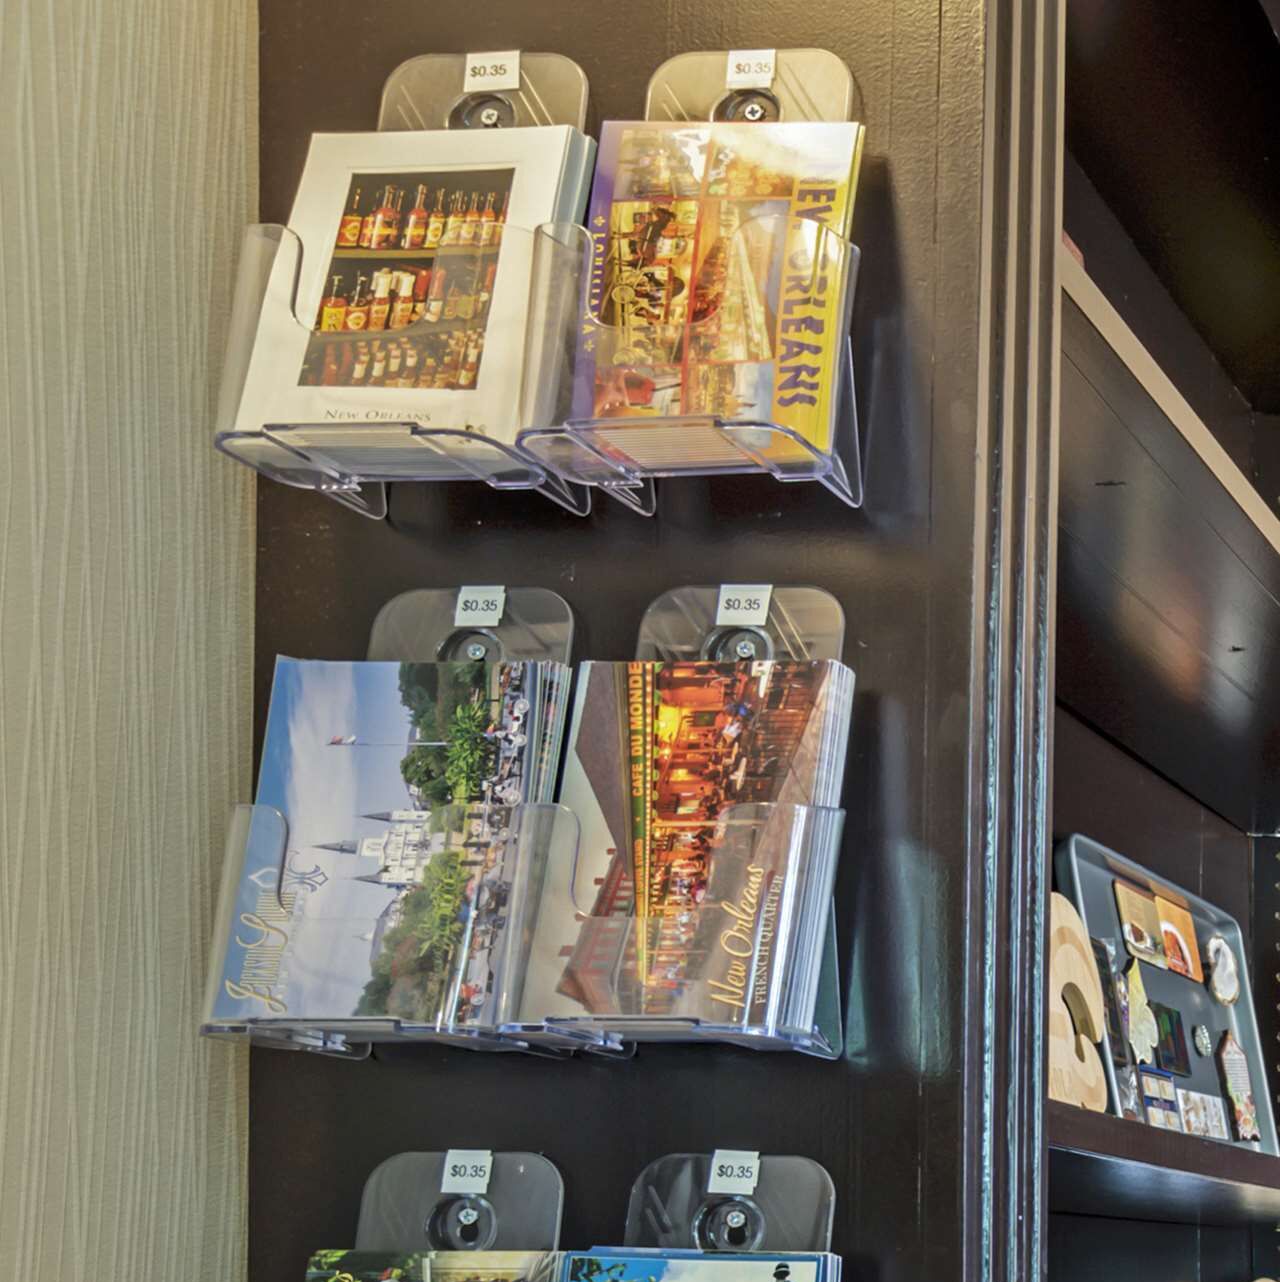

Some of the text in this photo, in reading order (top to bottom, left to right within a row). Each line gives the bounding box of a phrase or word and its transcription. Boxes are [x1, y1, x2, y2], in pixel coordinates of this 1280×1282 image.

[470, 64, 507, 78] $0.35
[734, 62, 771, 75] $0.35
[461, 599, 498, 612] $0.35
[724, 598, 761, 611] $0.35
[627, 661, 645, 798] CAFE DU MONDE
[708, 863, 765, 1008] New Orleans
[450, 1165, 487, 1179] $0.35
[716, 1164, 753, 1179] $0.35
